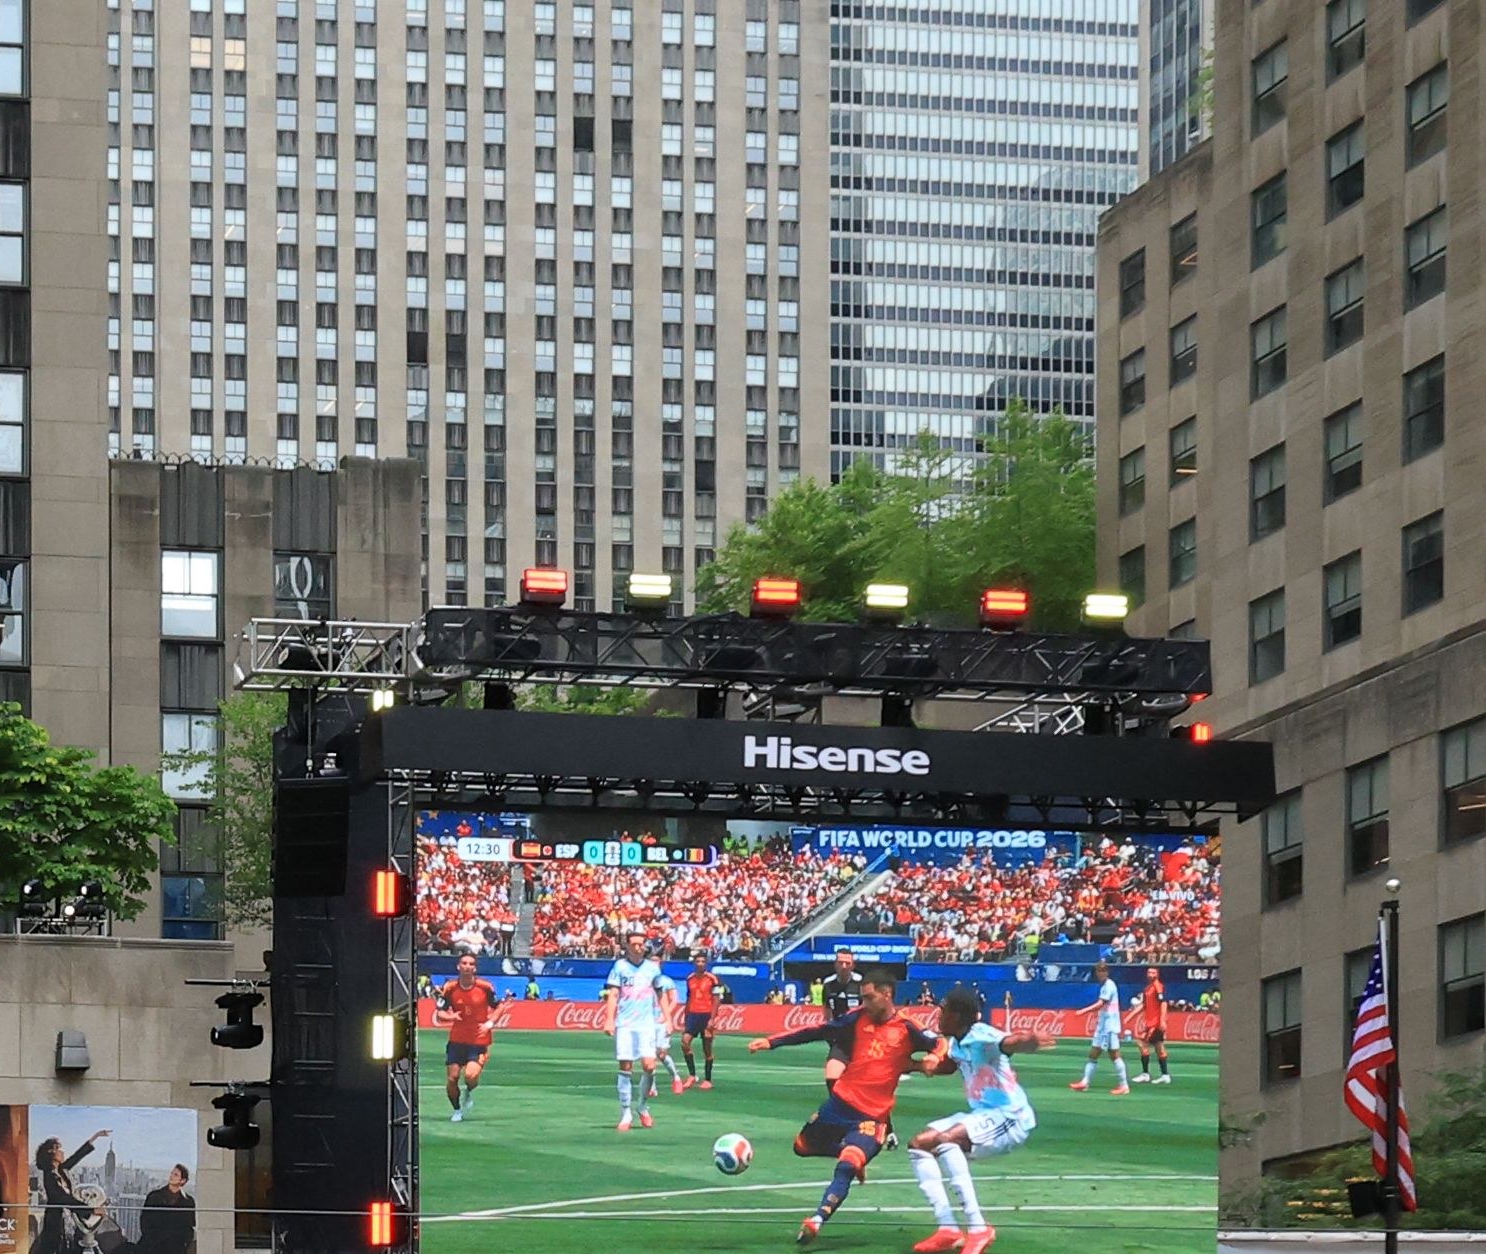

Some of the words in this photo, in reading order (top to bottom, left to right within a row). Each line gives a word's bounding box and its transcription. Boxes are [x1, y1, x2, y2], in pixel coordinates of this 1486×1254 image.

[744, 735, 930, 775] Hisense
[820, 830, 856, 847] FIFA
[936, 830, 974, 848] CUP
[978, 830, 1046, 848] 2026
[466, 843, 501, 855] 12:30
[555, 844, 579, 859] ESP
[590, 846, 598, 858] 0
[628, 848, 636, 860] 0
[647, 847, 669, 862] BEL
[1172, 890, 1194, 901] VIVO
